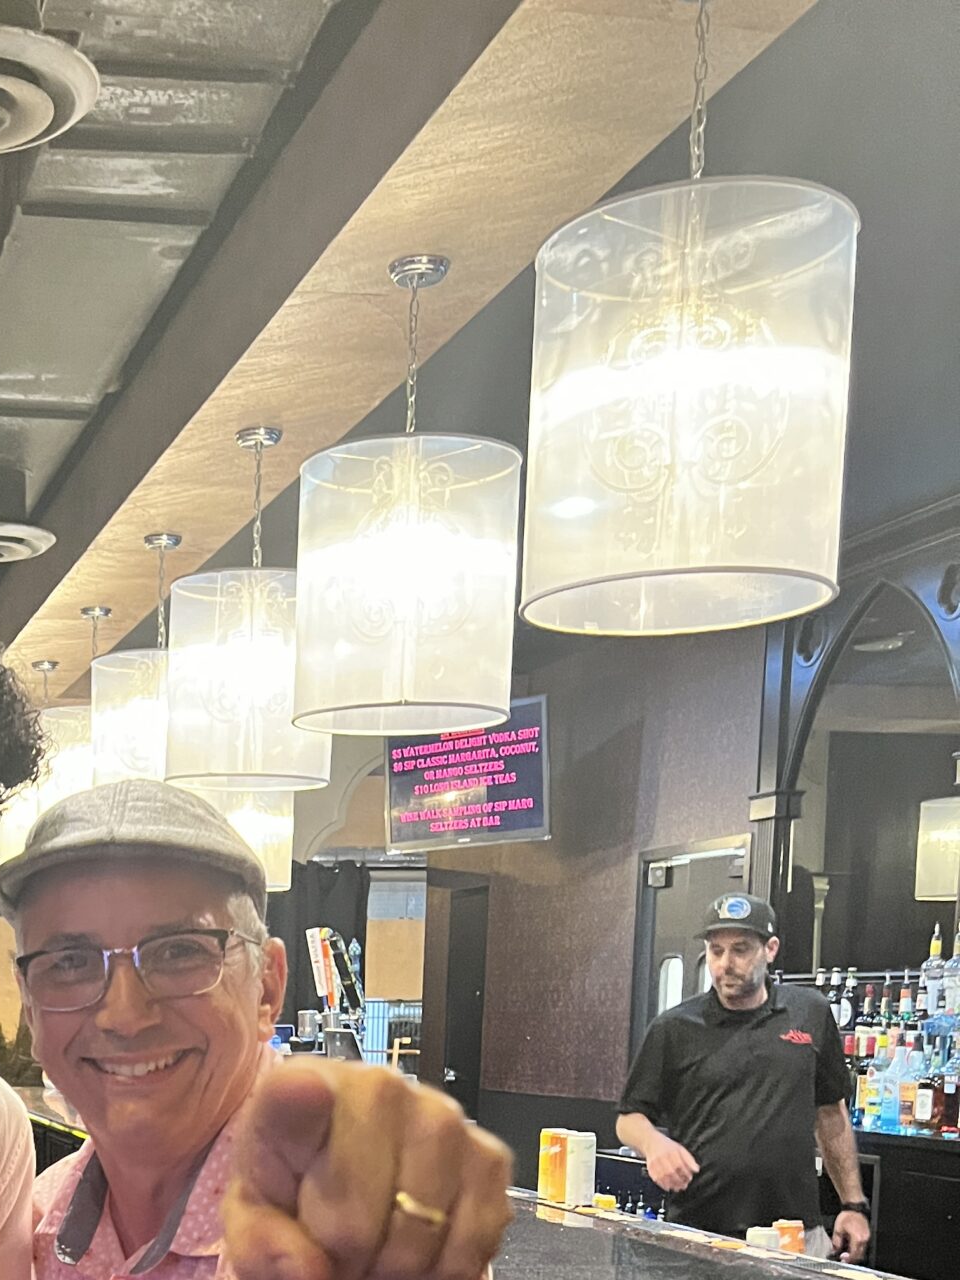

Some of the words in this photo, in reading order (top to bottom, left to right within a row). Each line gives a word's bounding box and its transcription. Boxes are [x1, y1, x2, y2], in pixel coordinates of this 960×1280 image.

[402, 741, 453, 758] WATERMELON
[455, 735, 487, 749] DELIGHT
[489, 731, 516, 744] VODKA
[518, 727, 540, 740] SHOT
[404, 760, 416, 770] SIP
[417, 755, 448, 768] CLASSIC
[500, 742, 539, 756] COCONUT,
[424, 770, 435, 781] OR
[436, 767, 463, 779] MANGO
[464, 760, 505, 775] SELTZERS
[414, 784, 429, 795] $10
[430, 781, 449, 793] LONG
[450, 778, 478, 791] ISLAND
[480, 775, 493, 786] ICE
[494, 772, 517, 785] TEAS
[420, 809, 441, 820] WALK
[442, 804, 481, 817] SAMPLING
[482, 802, 493, 813] OF
[494, 800, 508, 811] SIP
[508, 798, 534, 810] MARG
[430, 819, 469, 832] SELTZERS
[470, 818, 482, 828] AT
[482, 816, 501, 826] BAR
